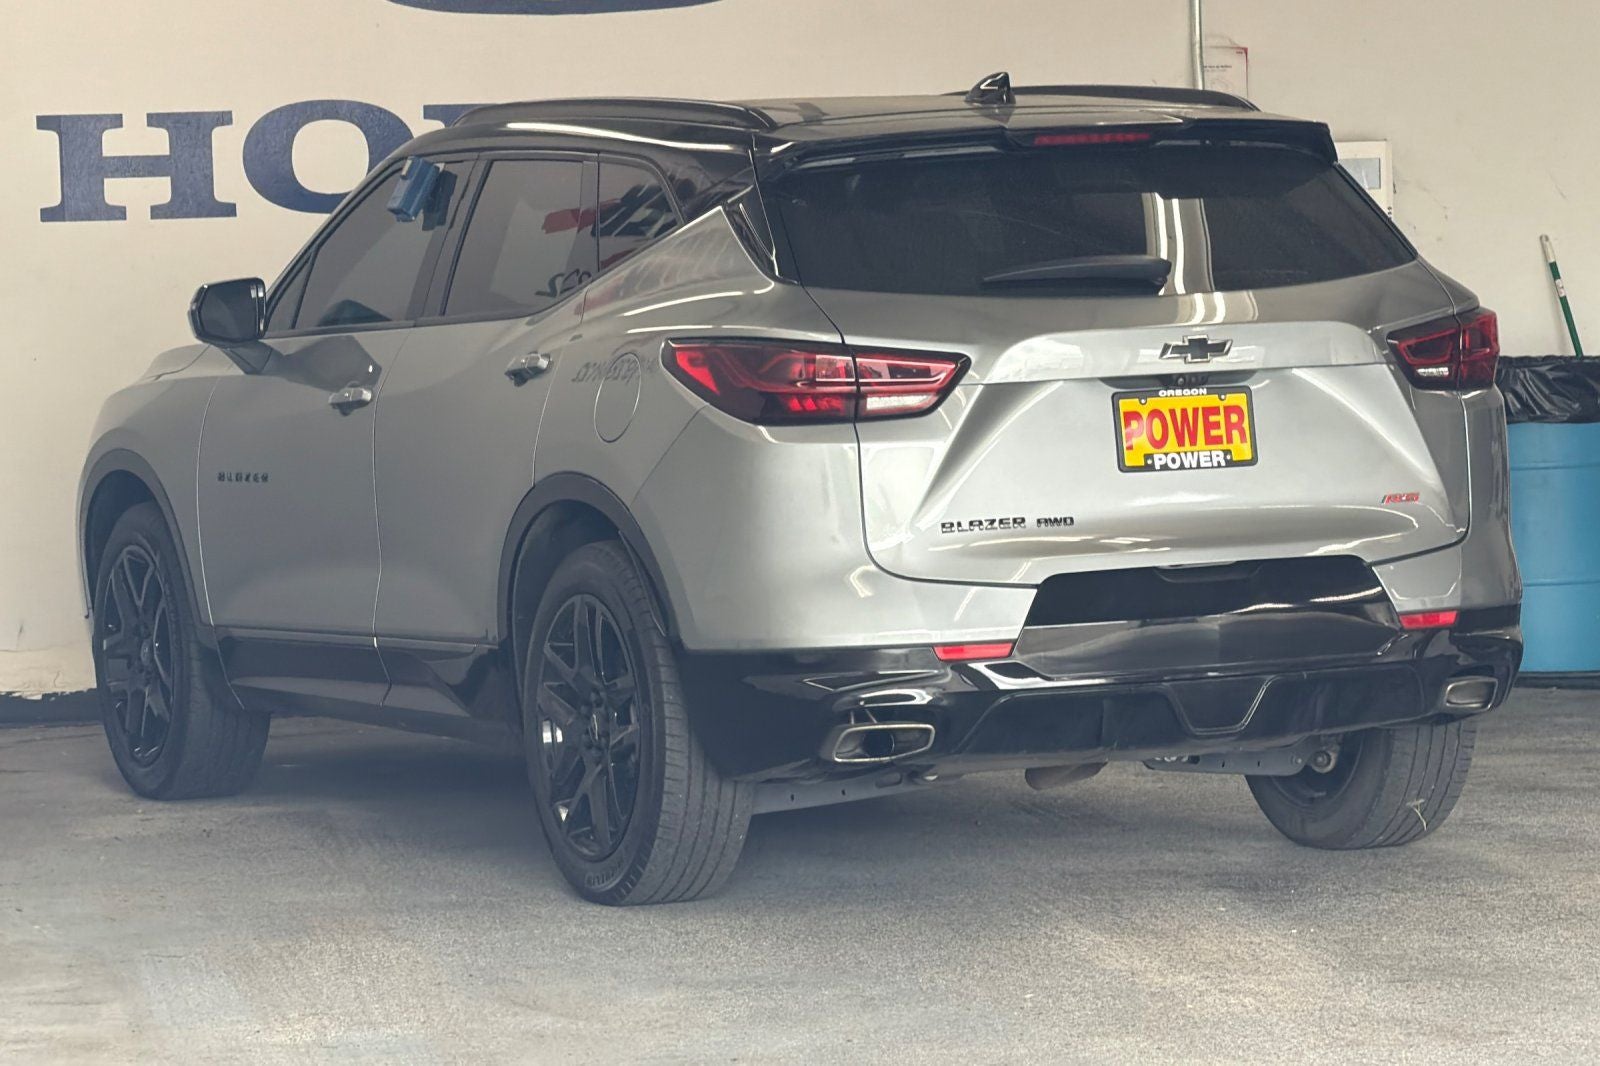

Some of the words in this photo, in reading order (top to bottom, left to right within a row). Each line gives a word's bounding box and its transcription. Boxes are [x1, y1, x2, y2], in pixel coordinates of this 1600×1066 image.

[36, 99, 490, 222] HO
[1158, 388, 1207, 397] OREGON
[1123, 405, 1247, 450] POWER
[1154, 450, 1225, 469] POWER
[940, 516, 1026, 534] BLAZER
[1036, 516, 1075, 528] AWD
